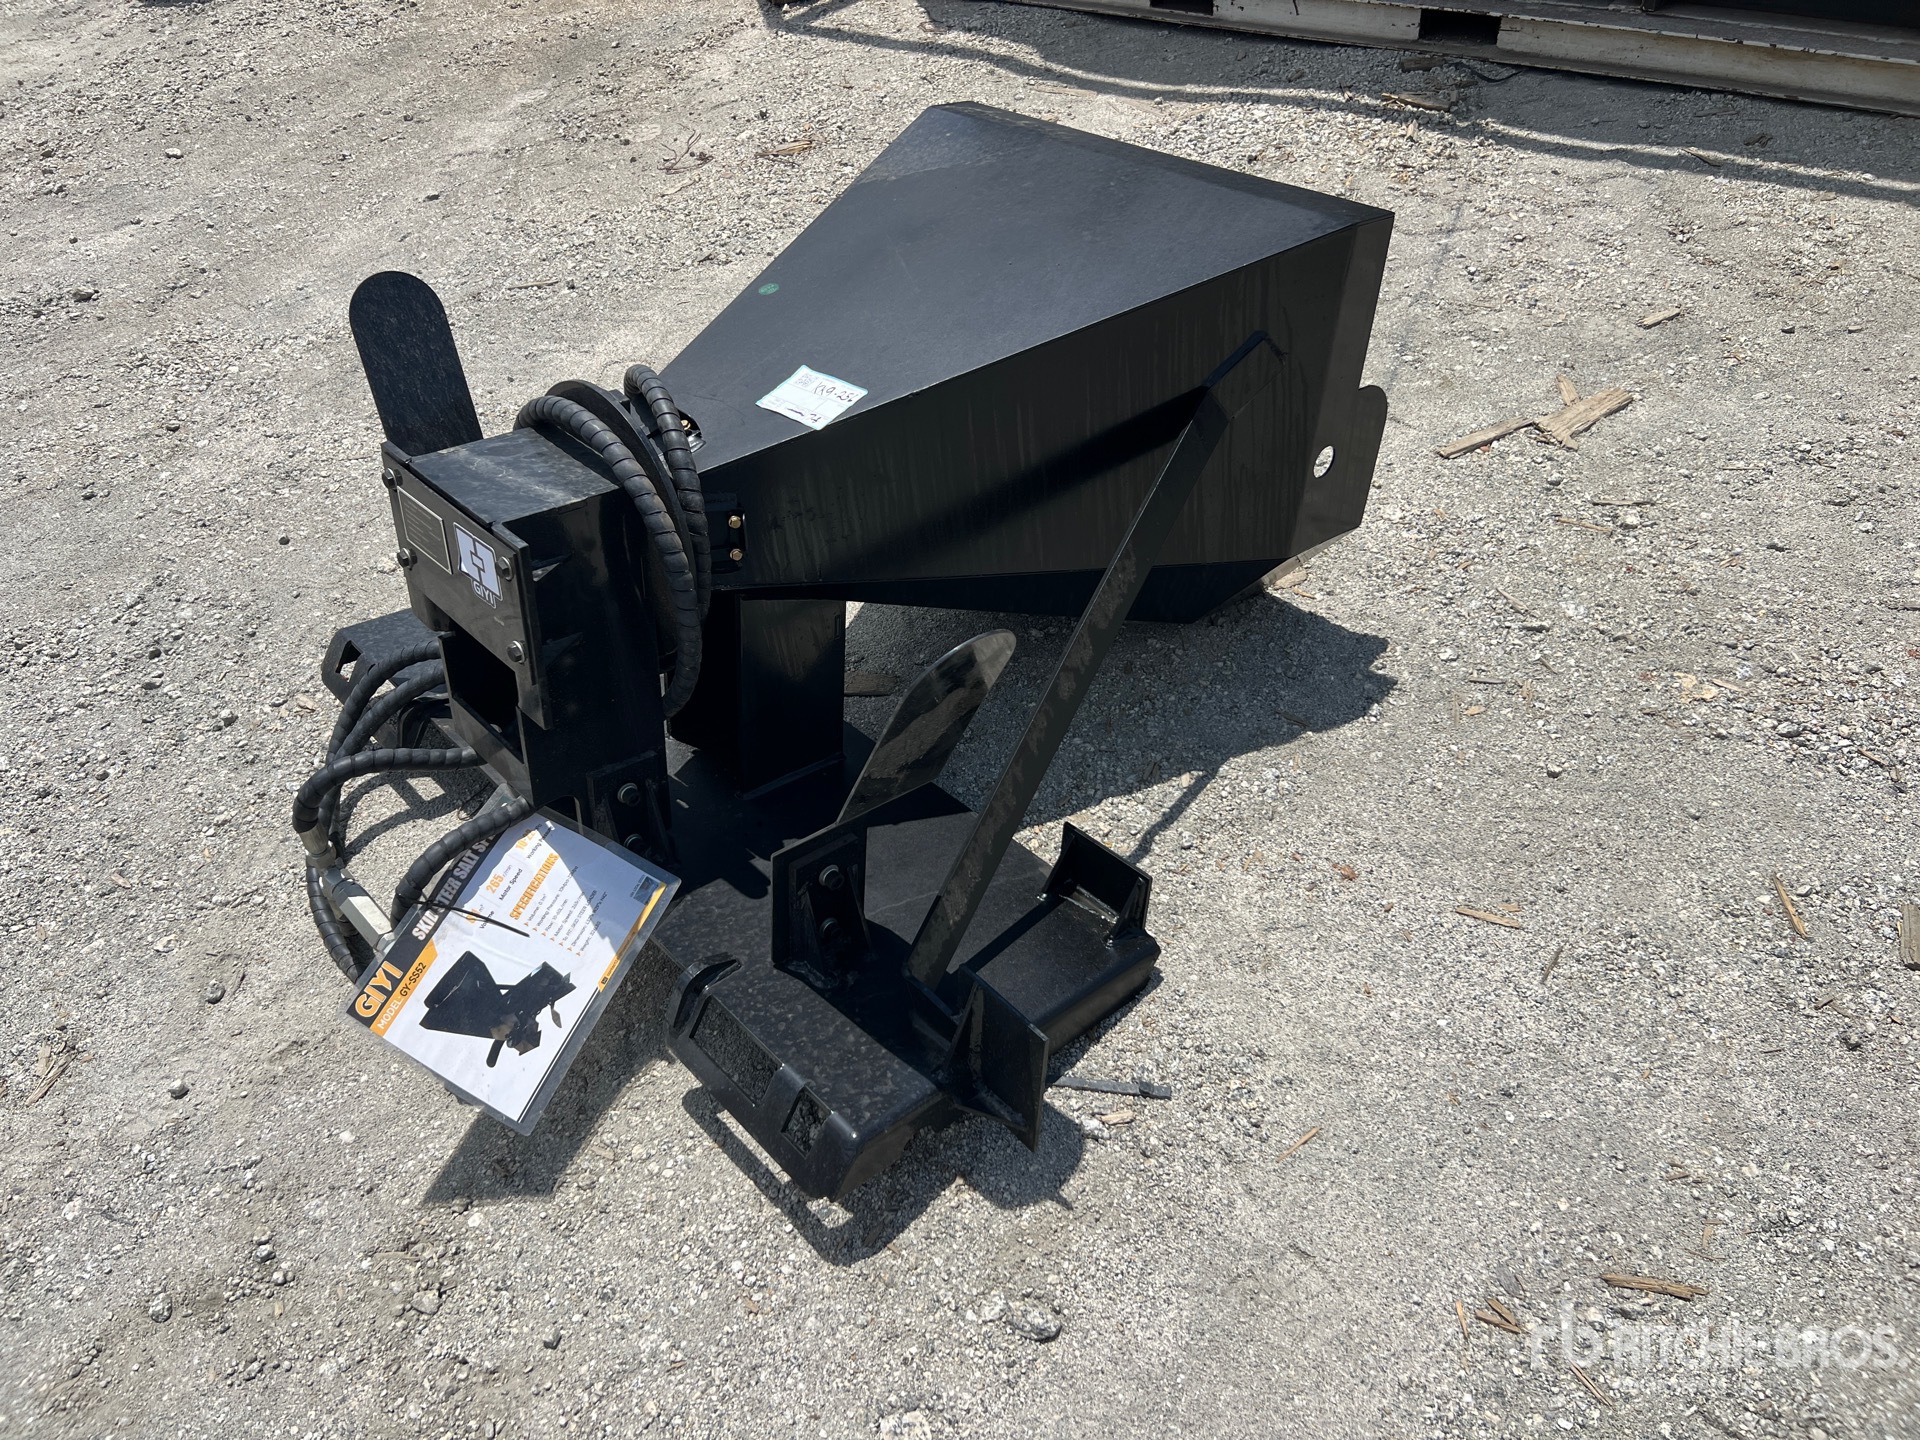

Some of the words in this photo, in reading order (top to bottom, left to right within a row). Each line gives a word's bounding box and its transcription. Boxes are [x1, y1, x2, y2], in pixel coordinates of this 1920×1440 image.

[473, 580, 494, 605] GIYI
[526, 840, 542, 860] Working
[410, 908, 440, 942] SKID
[453, 848, 481, 880] SALT
[498, 884, 511, 900] Motor
[508, 867, 523, 885] Speed
[509, 852, 559, 920] SPECIFICATIONS
[479, 909, 495, 930] Vome
[354, 960, 404, 1019] GIYI
[377, 998, 403, 1029] MODEL:
[398, 961, 426, 997] GY-SS52
